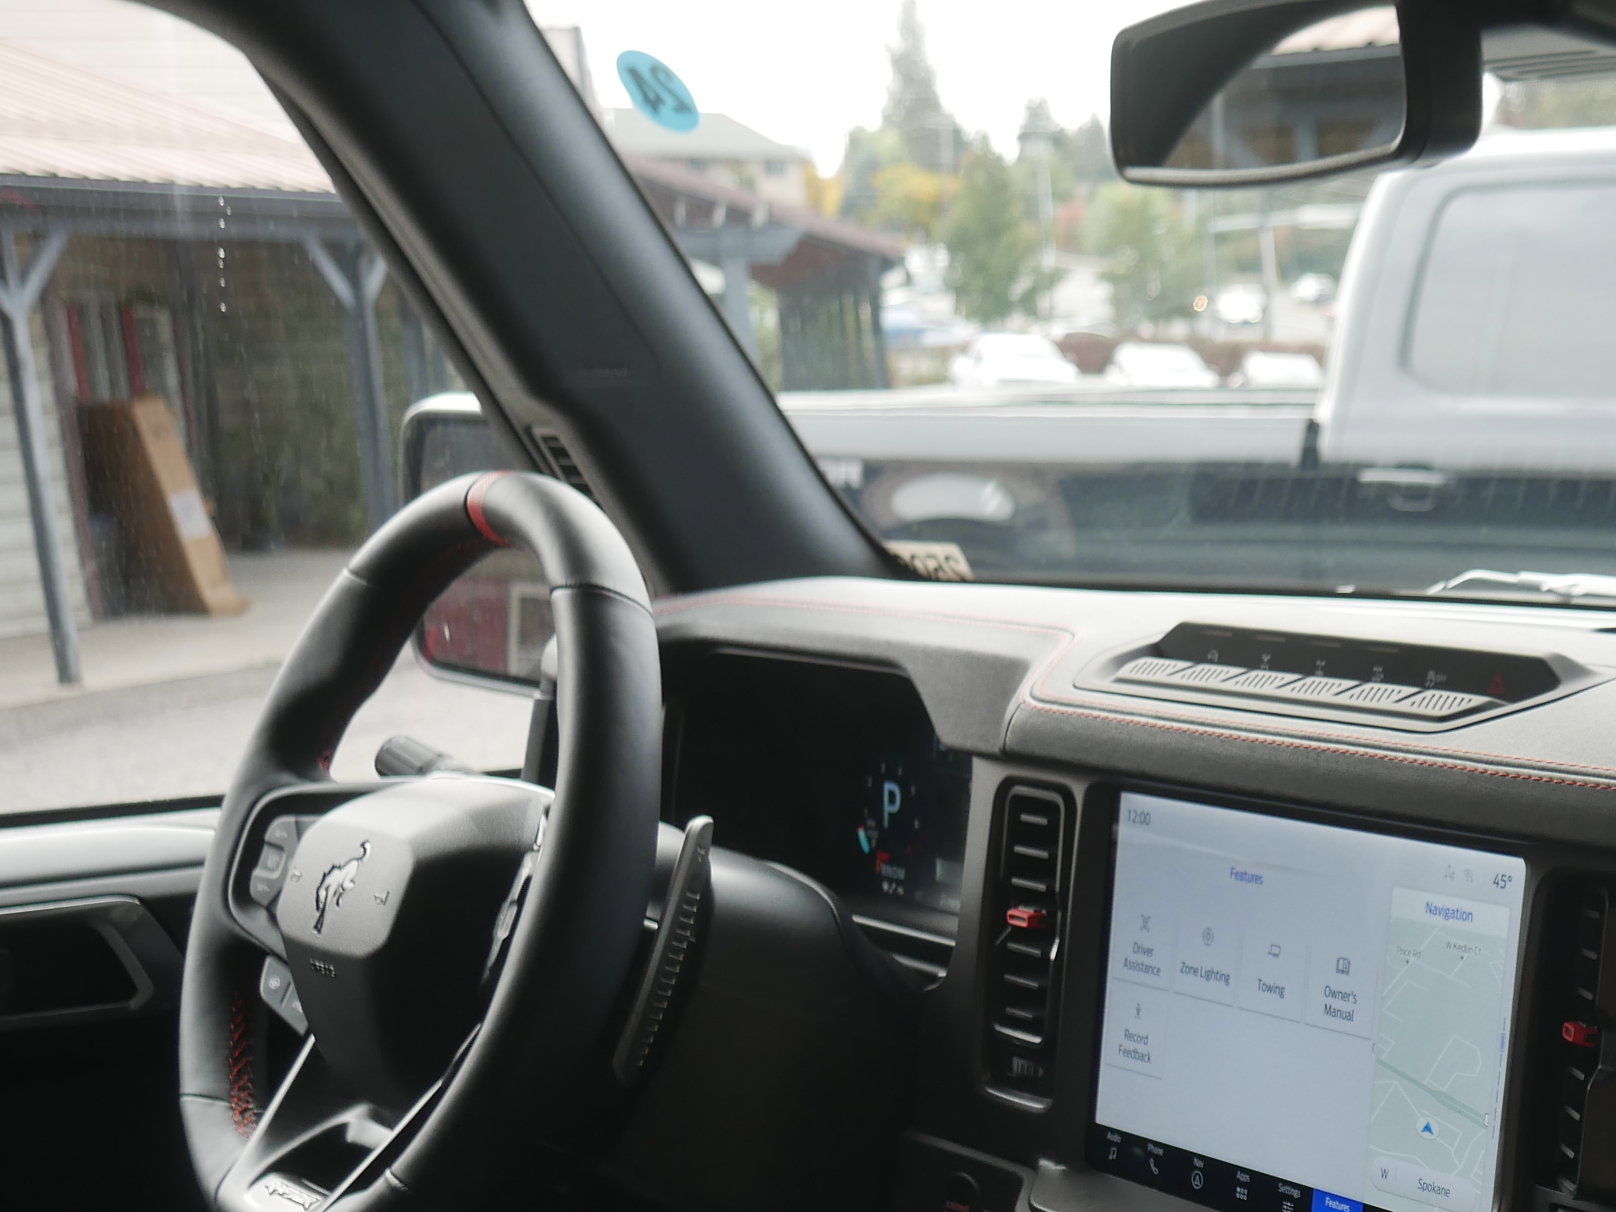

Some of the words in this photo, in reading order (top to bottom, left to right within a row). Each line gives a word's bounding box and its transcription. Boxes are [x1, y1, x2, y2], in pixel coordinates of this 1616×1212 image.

[883, 780, 902, 829] P
[1128, 808, 1151, 826] 12:00
[1230, 866, 1264, 886] Features
[1425, 901, 1474, 924] Navigation
[1132, 940, 1154, 958] Driver
[1123, 956, 1161, 977] Assistance
[1180, 960, 1199, 978] Zone
[1200, 965, 1231, 986] Lighting
[1258, 978, 1286, 999] Towing
[1324, 985, 1358, 1005] Owner's
[1324, 1003, 1354, 1023] Manual
[1124, 1028, 1149, 1046] Record
[1118, 1044, 1152, 1064] Feedback
[1106, 1130, 1122, 1144] Audio
[1148, 1142, 1164, 1157] Phone
[1193, 1156, 1204, 1168] Nav
[1236, 1170, 1250, 1183] Apps
[1380, 1168, 1390, 1180] W
[1278, 1182, 1301, 1198] Settings
[1417, 1178, 1451, 1198] Spokane
